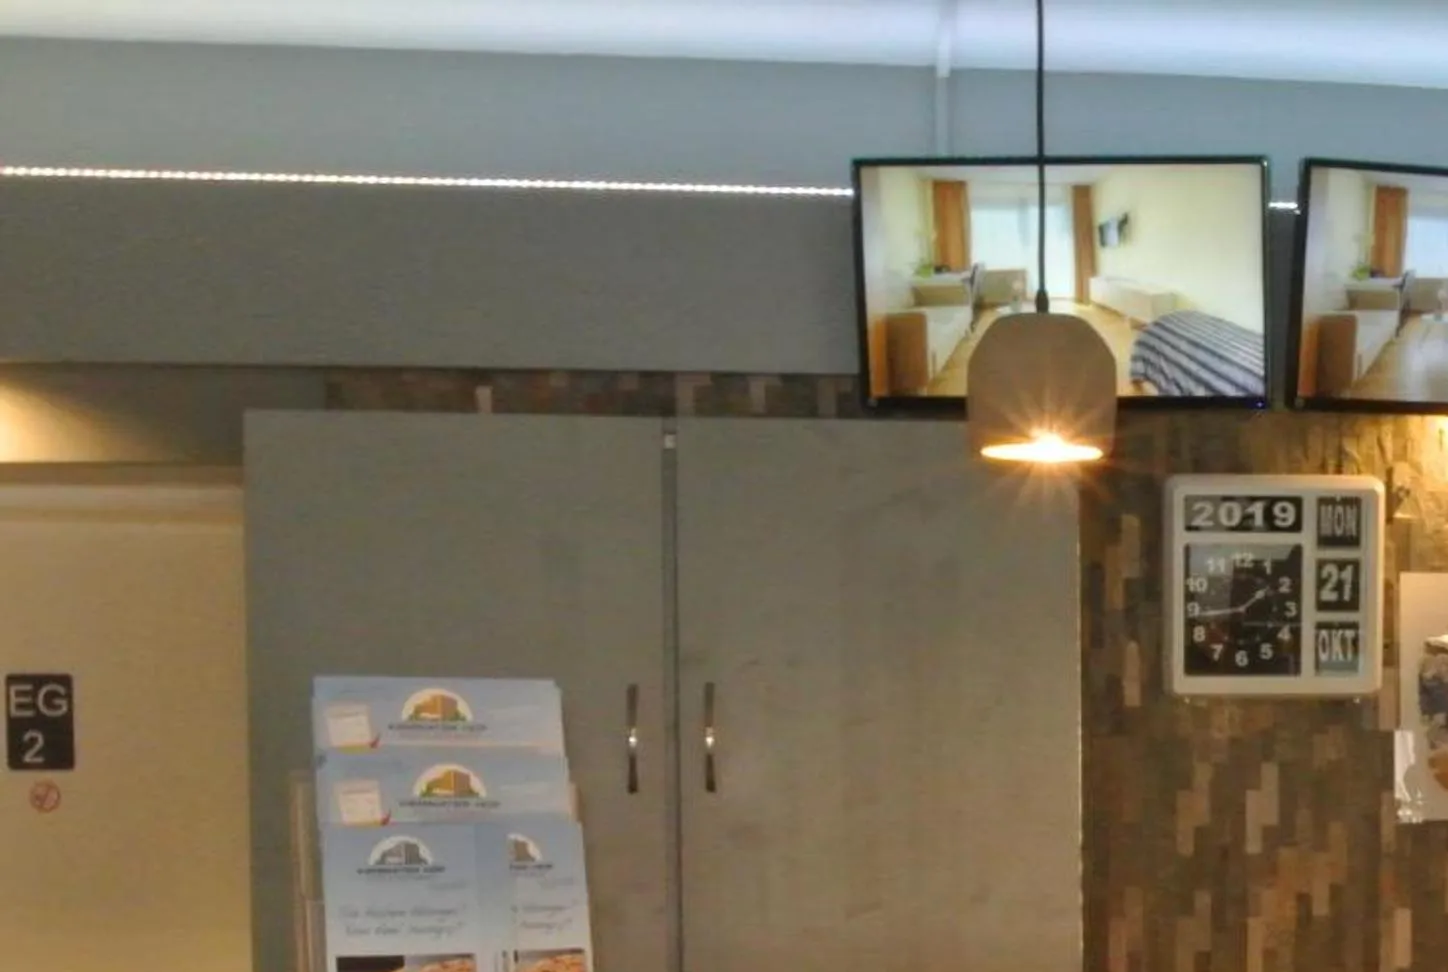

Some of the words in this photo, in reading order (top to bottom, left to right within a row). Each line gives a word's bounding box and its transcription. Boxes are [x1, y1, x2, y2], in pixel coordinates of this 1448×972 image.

[1190, 500, 1297, 527] 2019
[1320, 504, 1358, 537] MON
[1206, 557, 1226, 574] 11
[1263, 560, 1273, 575] 1
[1186, 577, 1208, 592] 10
[1279, 577, 1292, 592] 2
[1319, 562, 1355, 602] 21
[1187, 603, 1200, 617] 9
[1284, 602, 1298, 617] 3
[1193, 626, 1206, 642] 8
[1277, 625, 1291, 640] 4
[1210, 644, 1224, 661] 7
[1259, 643, 1274, 660] 5
[1317, 628, 1356, 662] OKT
[1234, 651, 1249, 667] 6
[9, 683, 69, 718] EG
[22, 729, 45, 764] 2
